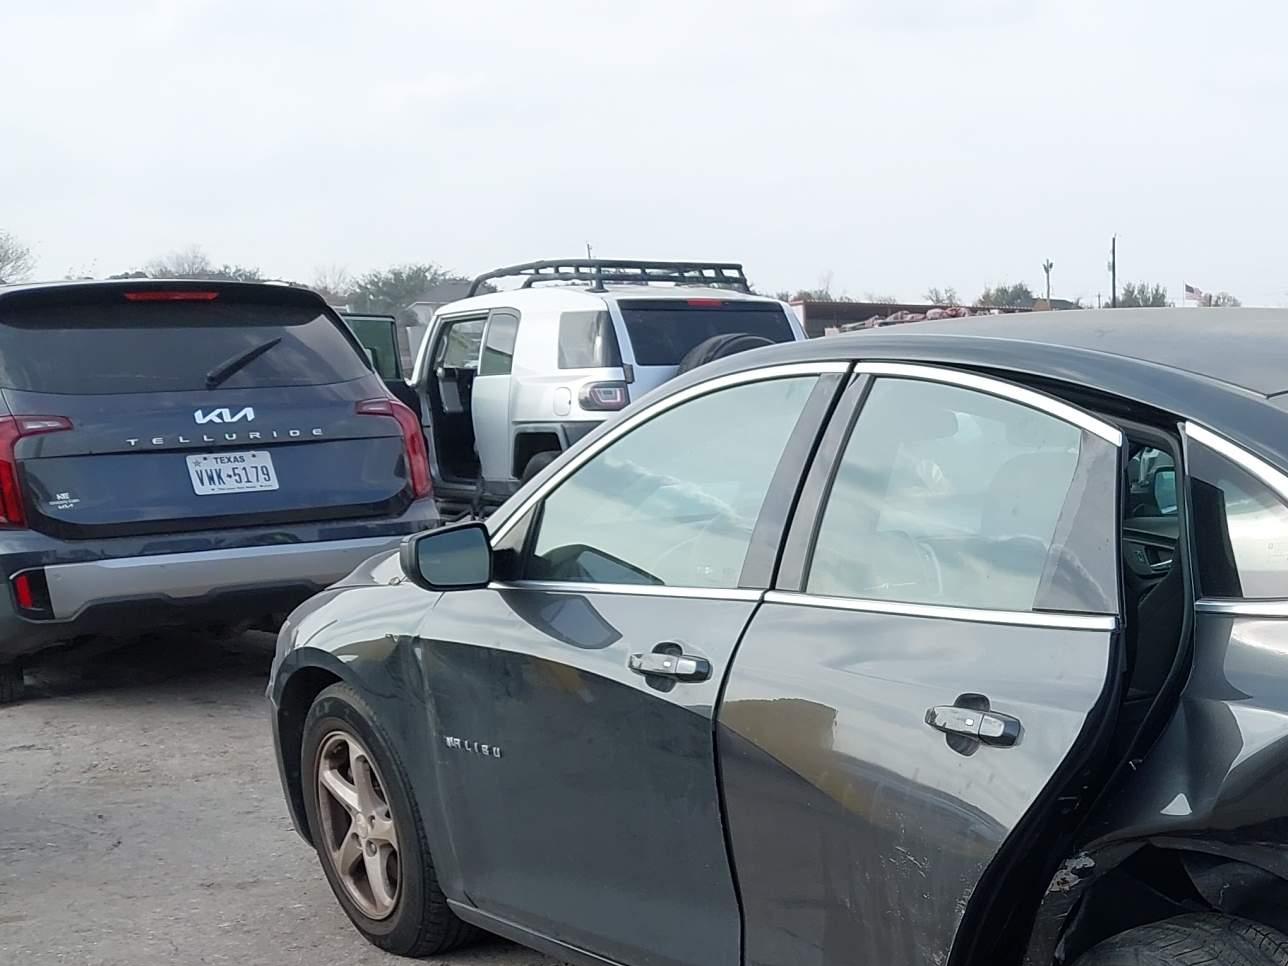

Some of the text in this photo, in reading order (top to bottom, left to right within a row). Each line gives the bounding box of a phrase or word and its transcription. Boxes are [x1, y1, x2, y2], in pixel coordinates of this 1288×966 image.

[194, 407, 255, 424] KIA
[126, 428, 324, 446] TELLURIDE
[213, 455, 246, 464] TEXAS
[444, 736, 501, 758] MALIBU
